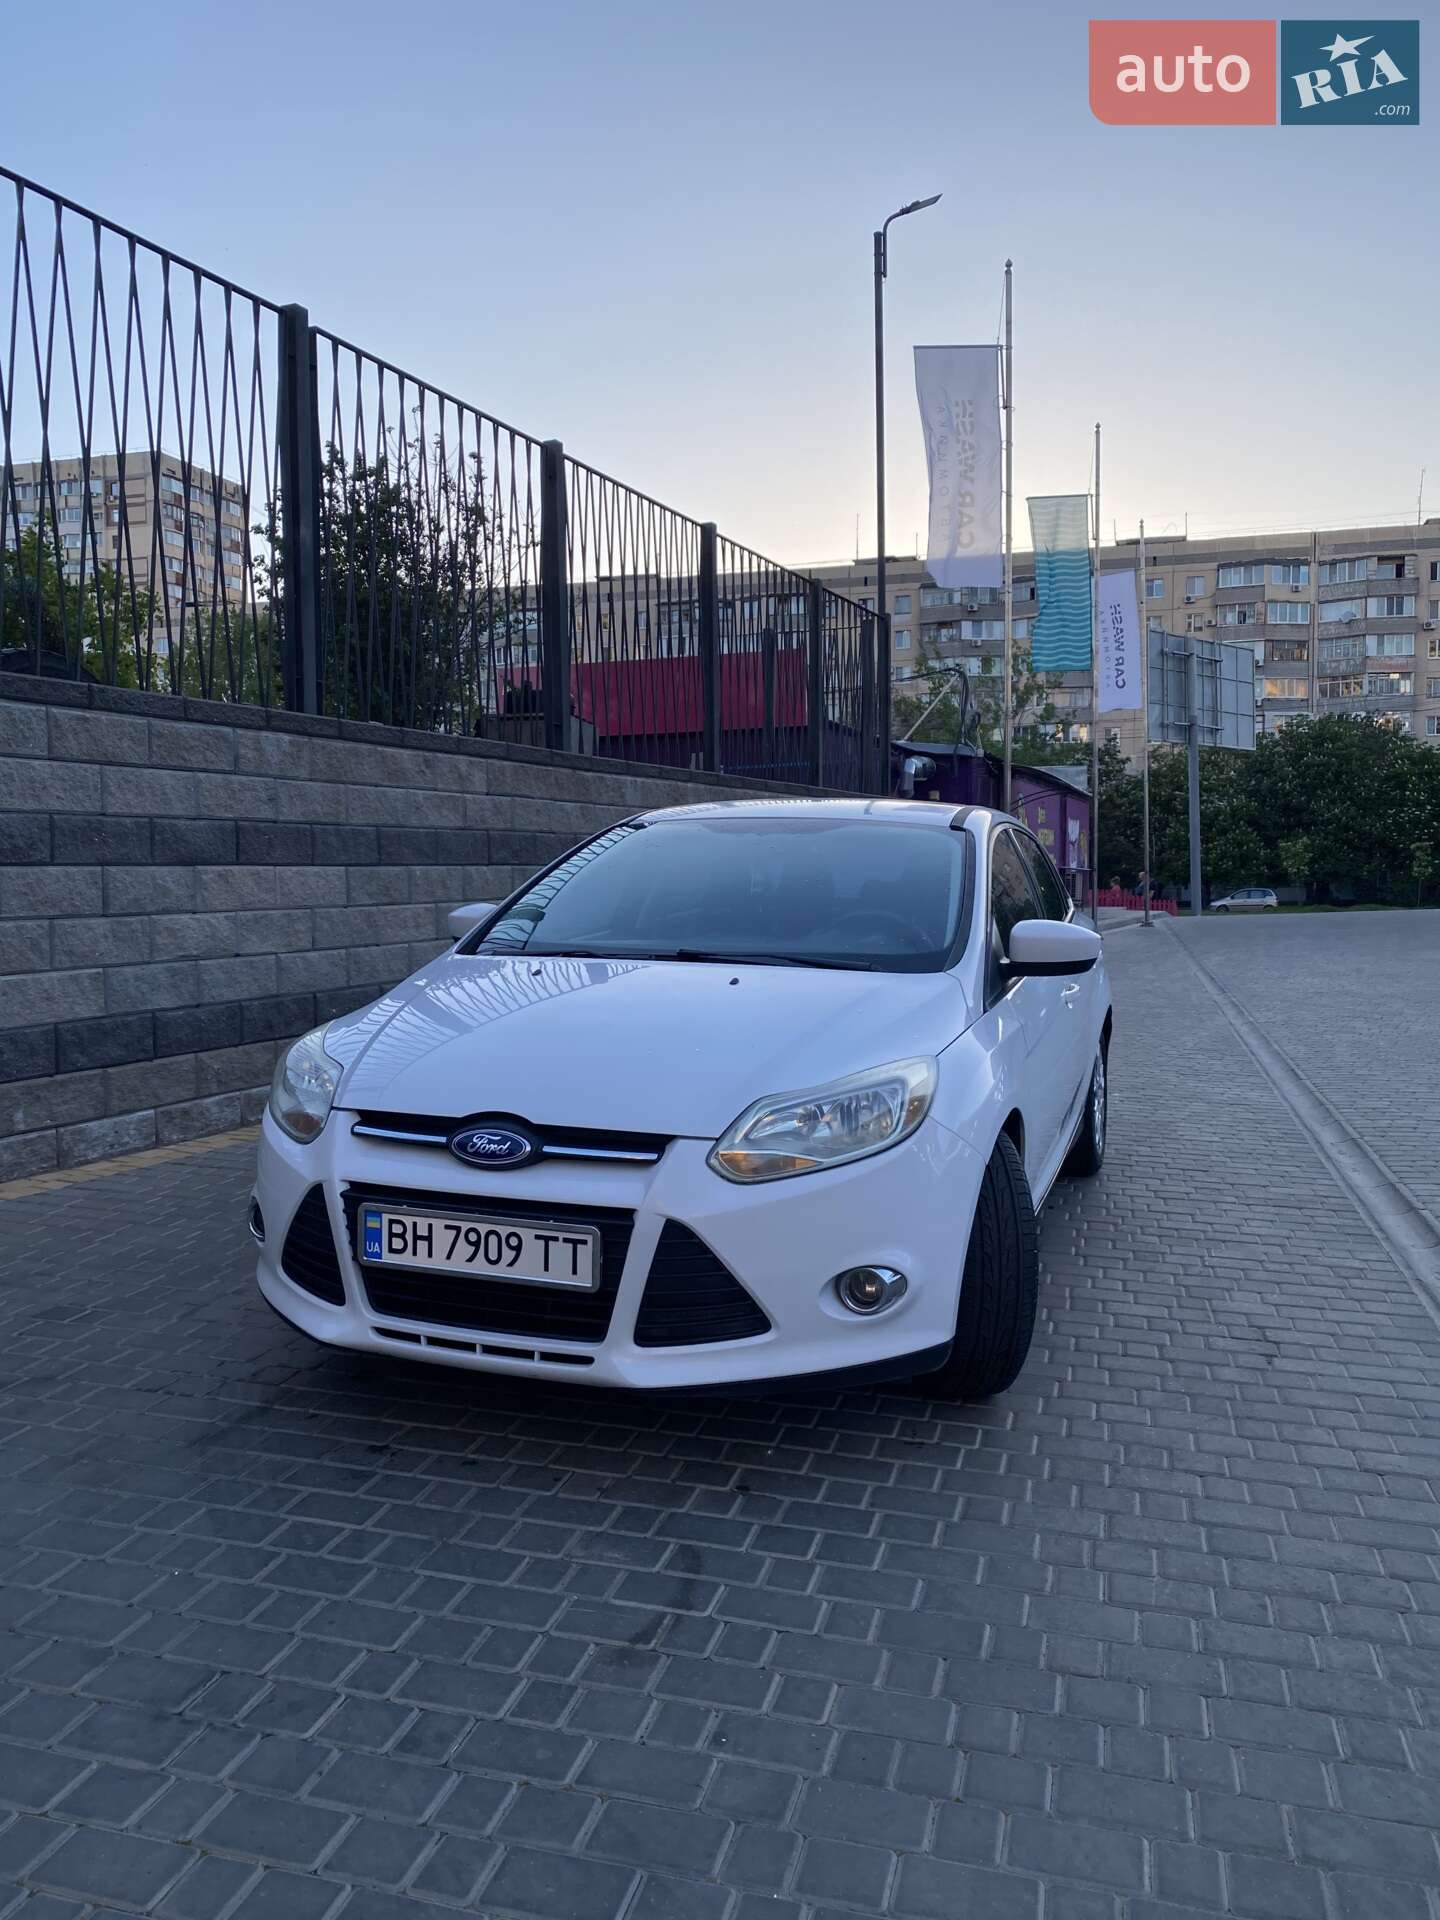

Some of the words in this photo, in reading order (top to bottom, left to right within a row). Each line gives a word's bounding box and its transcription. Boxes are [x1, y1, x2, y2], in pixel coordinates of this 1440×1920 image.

[466, 1133, 510, 1154] Ford
[366, 1241, 381, 1254] UA
[387, 1218, 433, 1258] BH
[444, 1224, 523, 1267] 7909
[534, 1234, 588, 1276] TT
